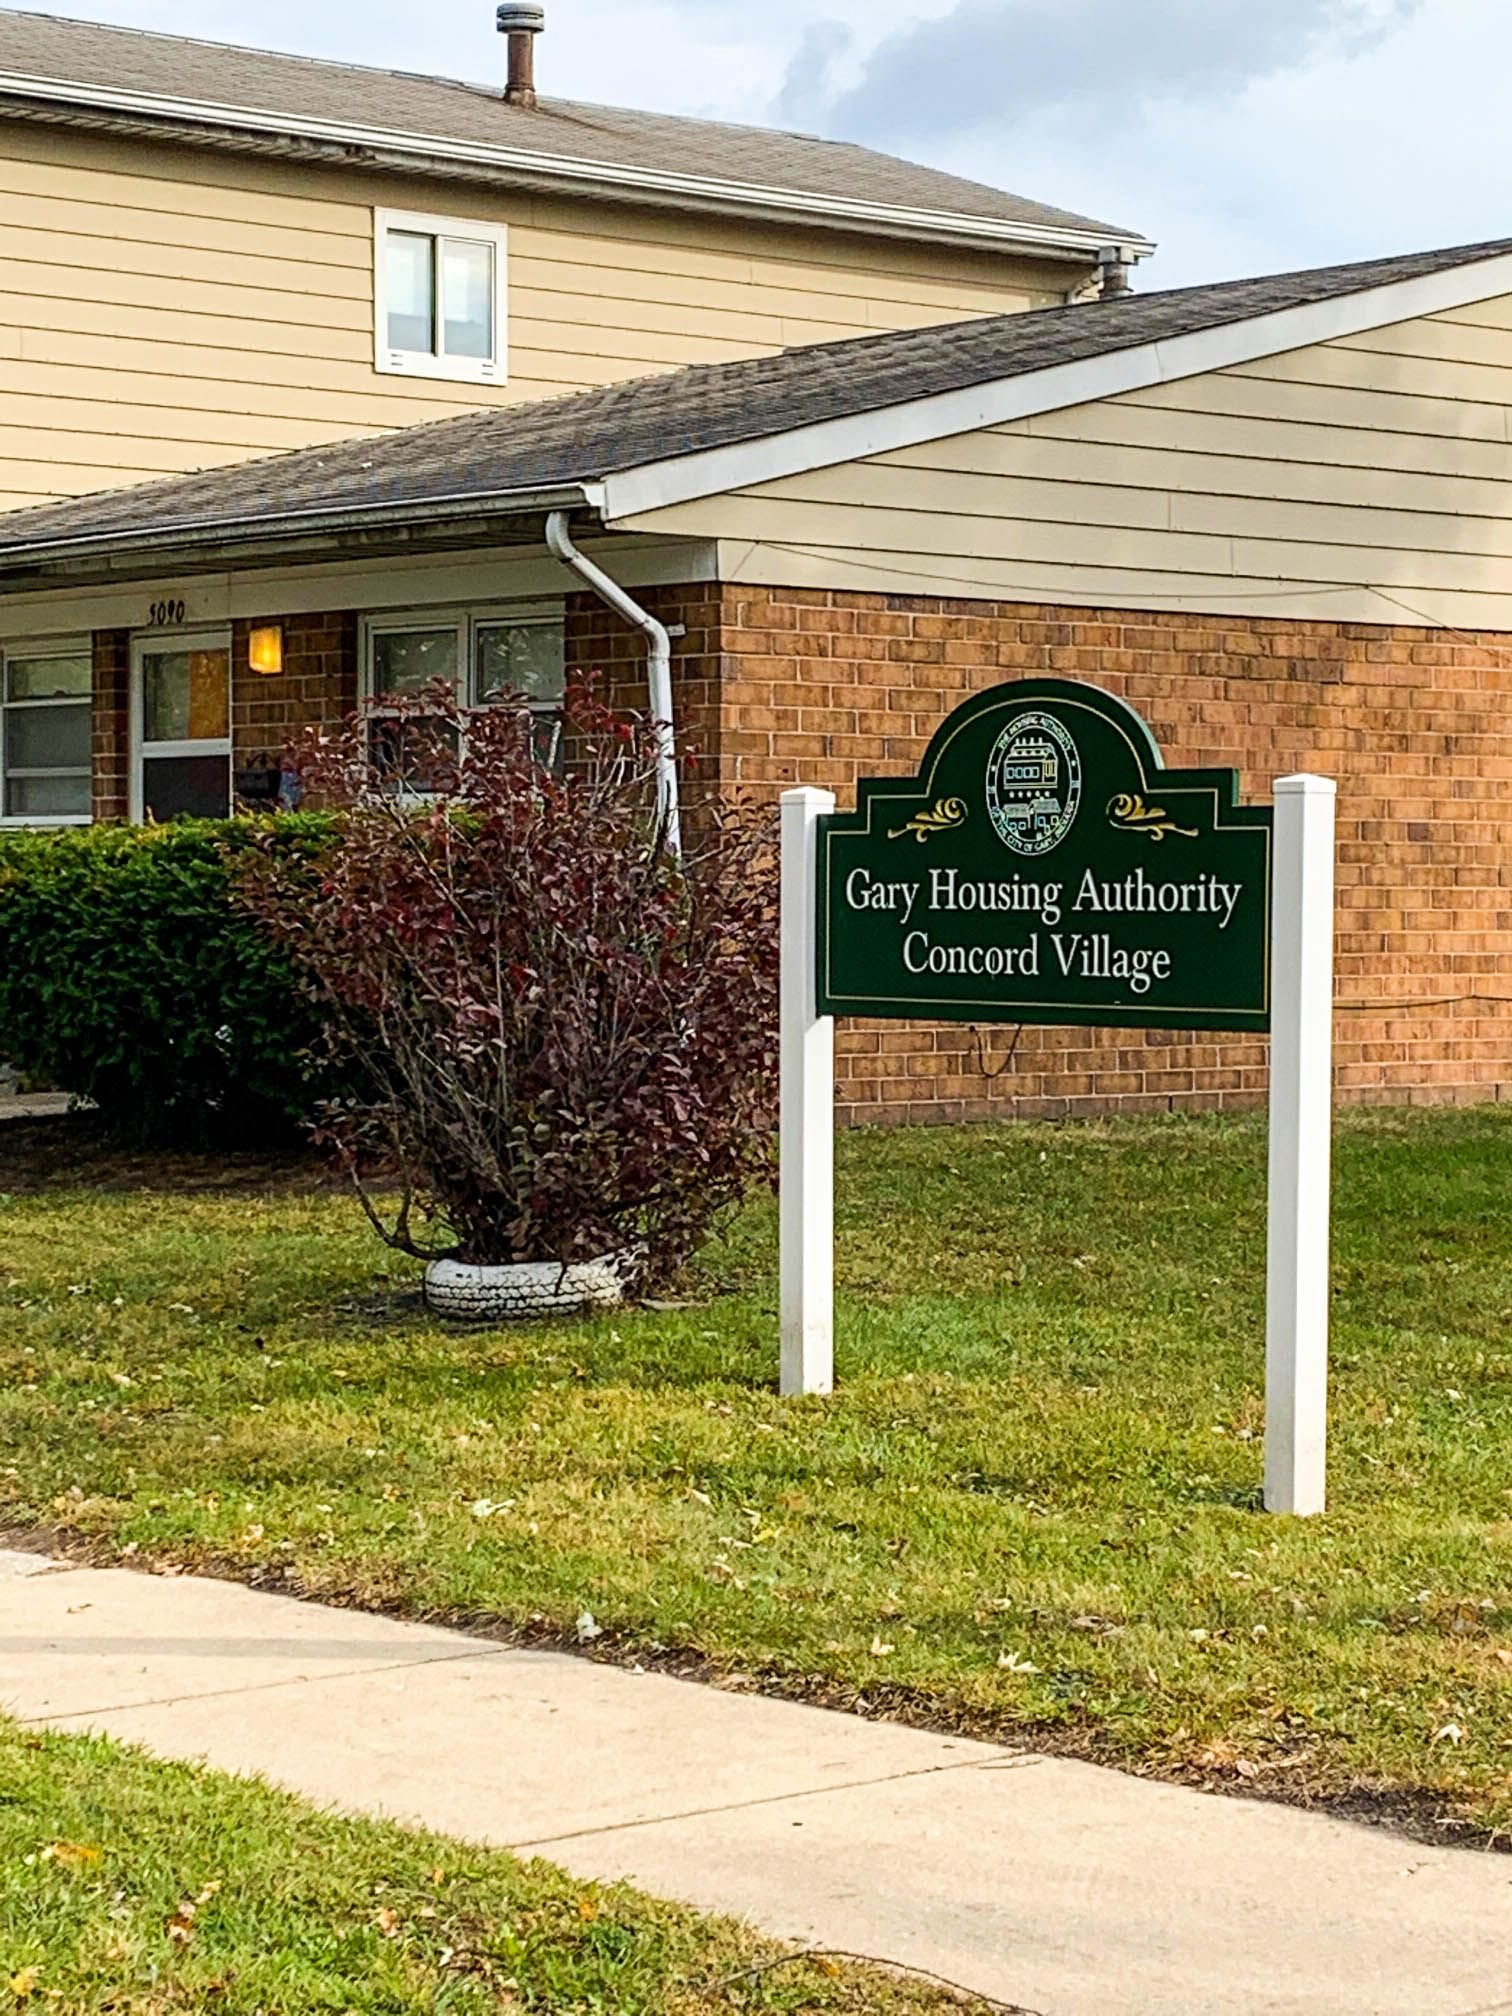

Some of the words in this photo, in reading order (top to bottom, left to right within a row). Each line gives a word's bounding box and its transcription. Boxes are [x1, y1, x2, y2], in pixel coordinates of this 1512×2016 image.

[846, 868, 919, 923] Gary
[928, 868, 1063, 926] Housing
[1072, 867, 1242, 929] Authority
[903, 931, 1039, 976] Concord
[1050, 934, 1171, 994] Village
